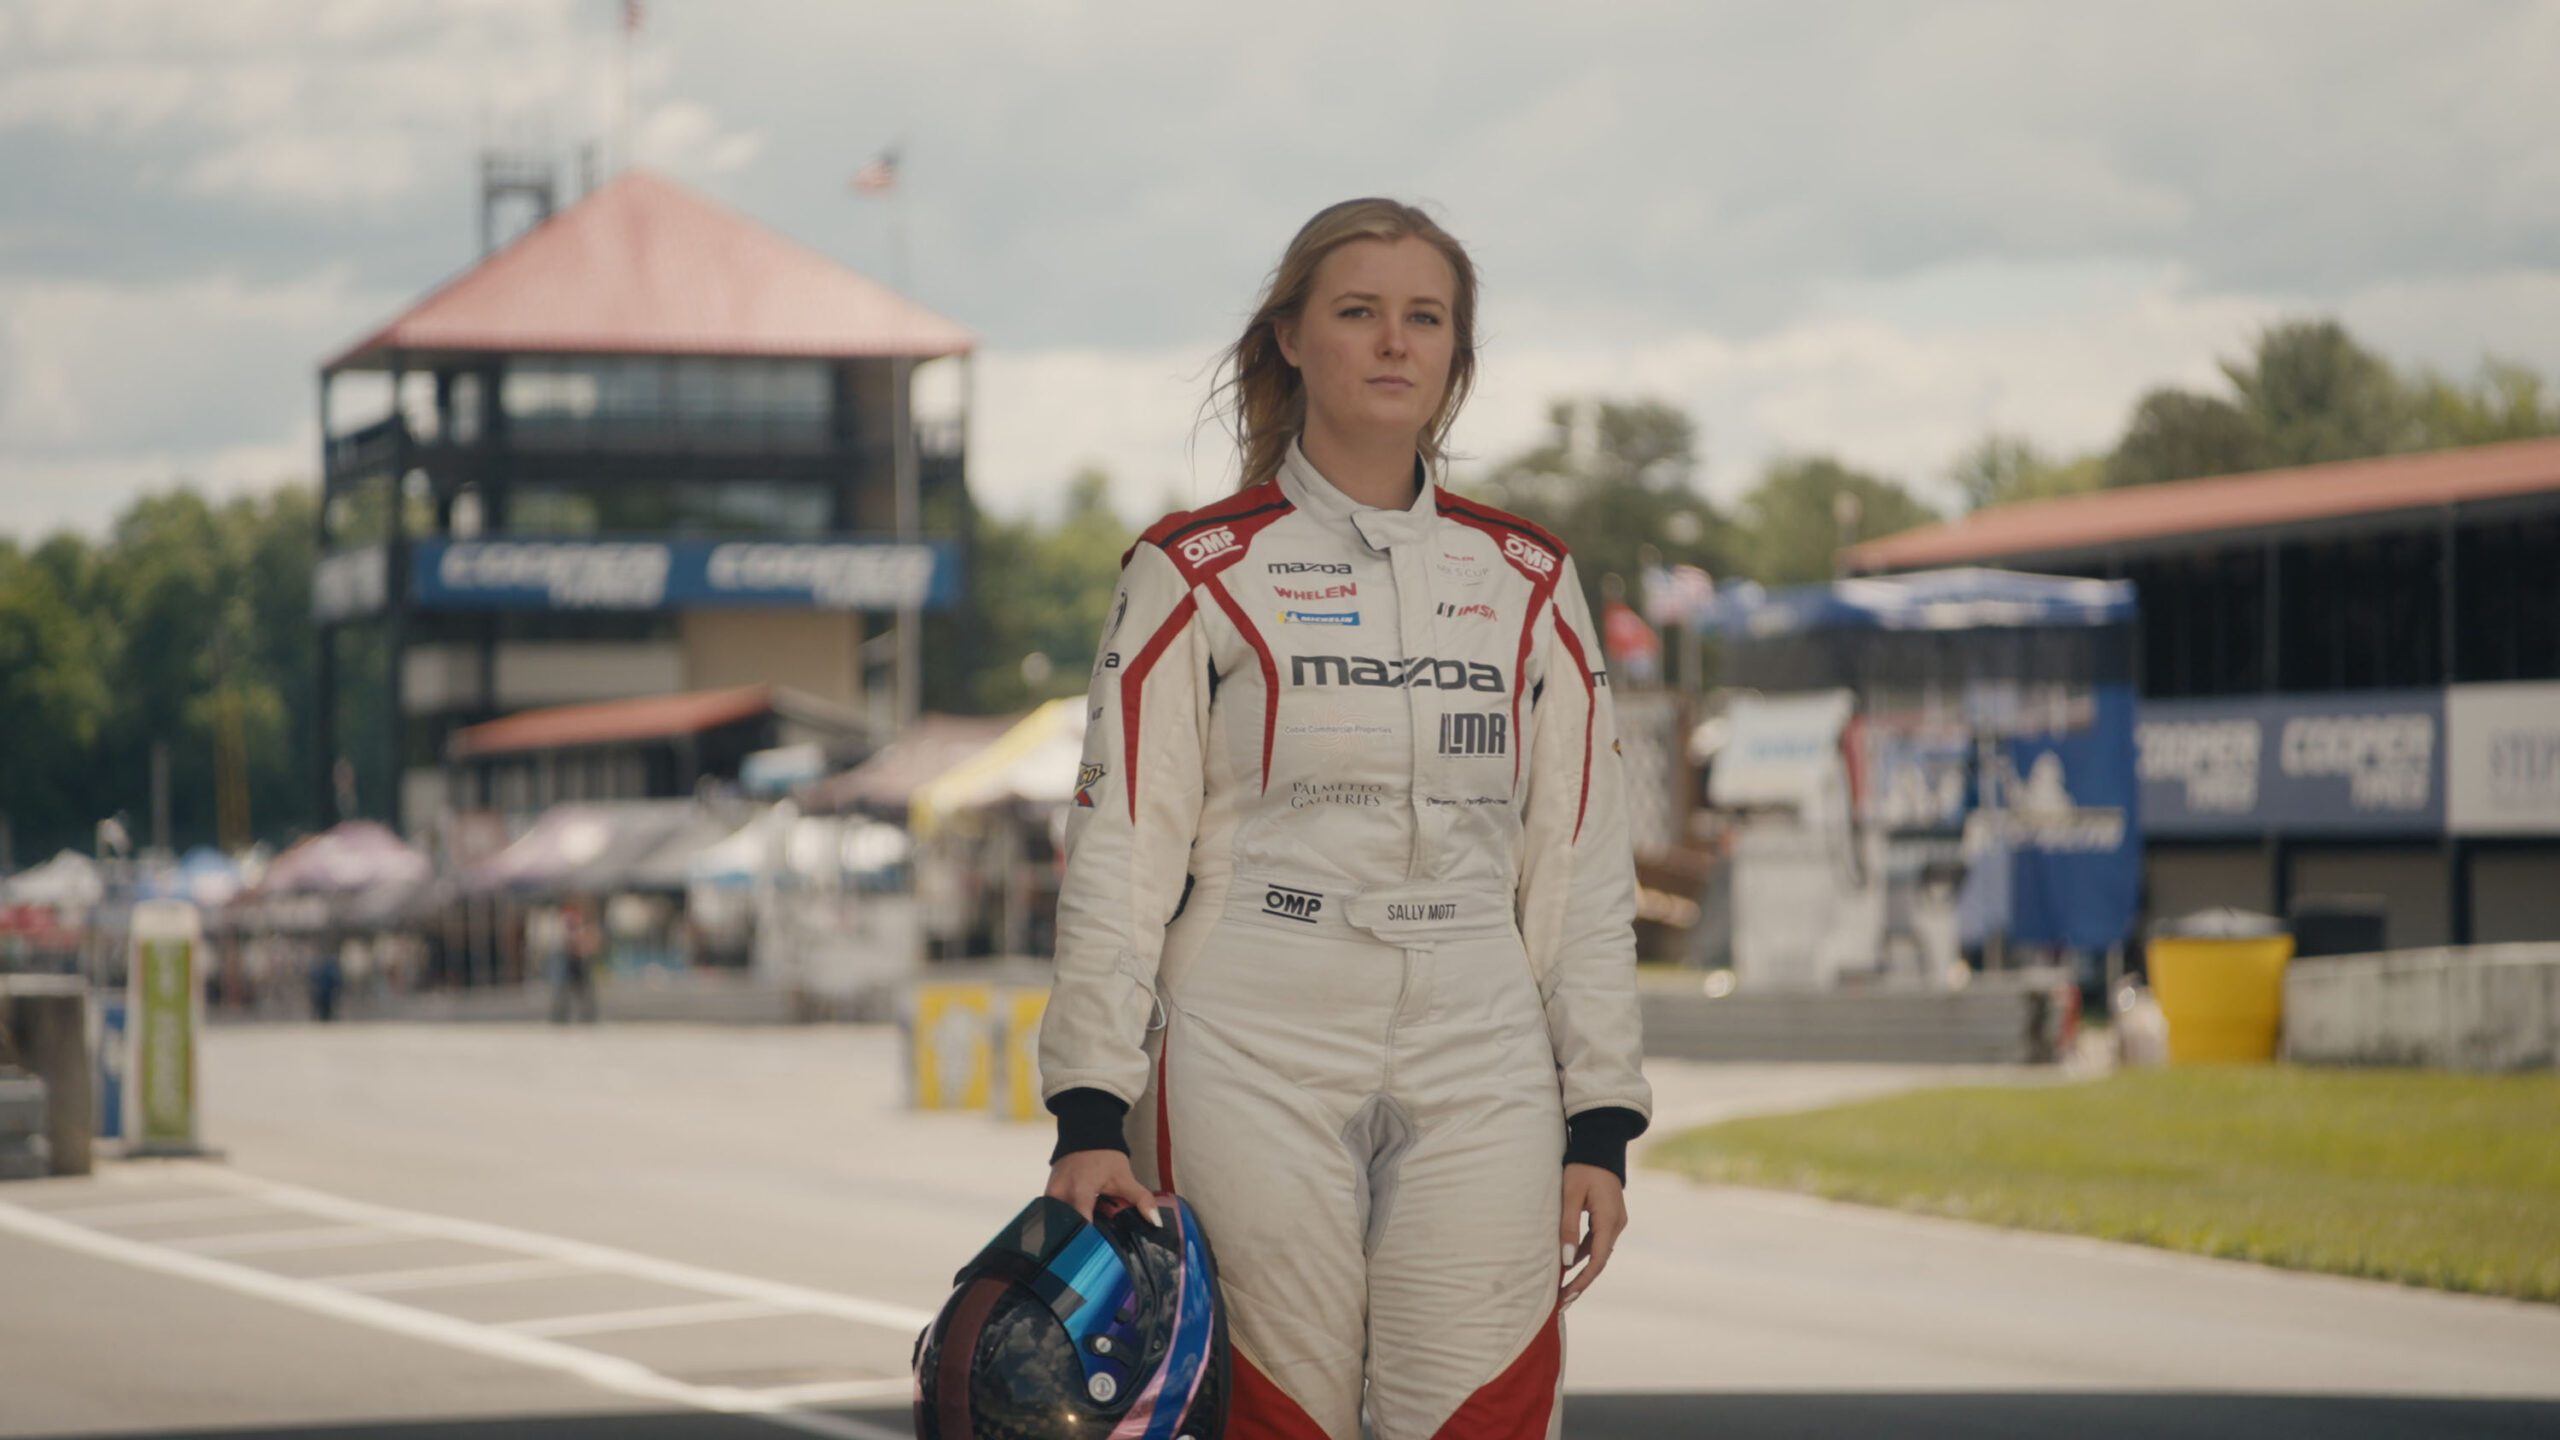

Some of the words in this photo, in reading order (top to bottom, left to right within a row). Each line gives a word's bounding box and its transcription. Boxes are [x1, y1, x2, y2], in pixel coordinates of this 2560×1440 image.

[1184, 530, 1236, 562] OMP
[1505, 538, 1554, 573] OMP
[1273, 582, 1358, 601] WHELEN
[1291, 655, 1506, 693] mazda
[1265, 890, 1322, 917] OMP
[1387, 904, 1425, 921] SALLY
[1427, 904, 1457, 921] MOTT
